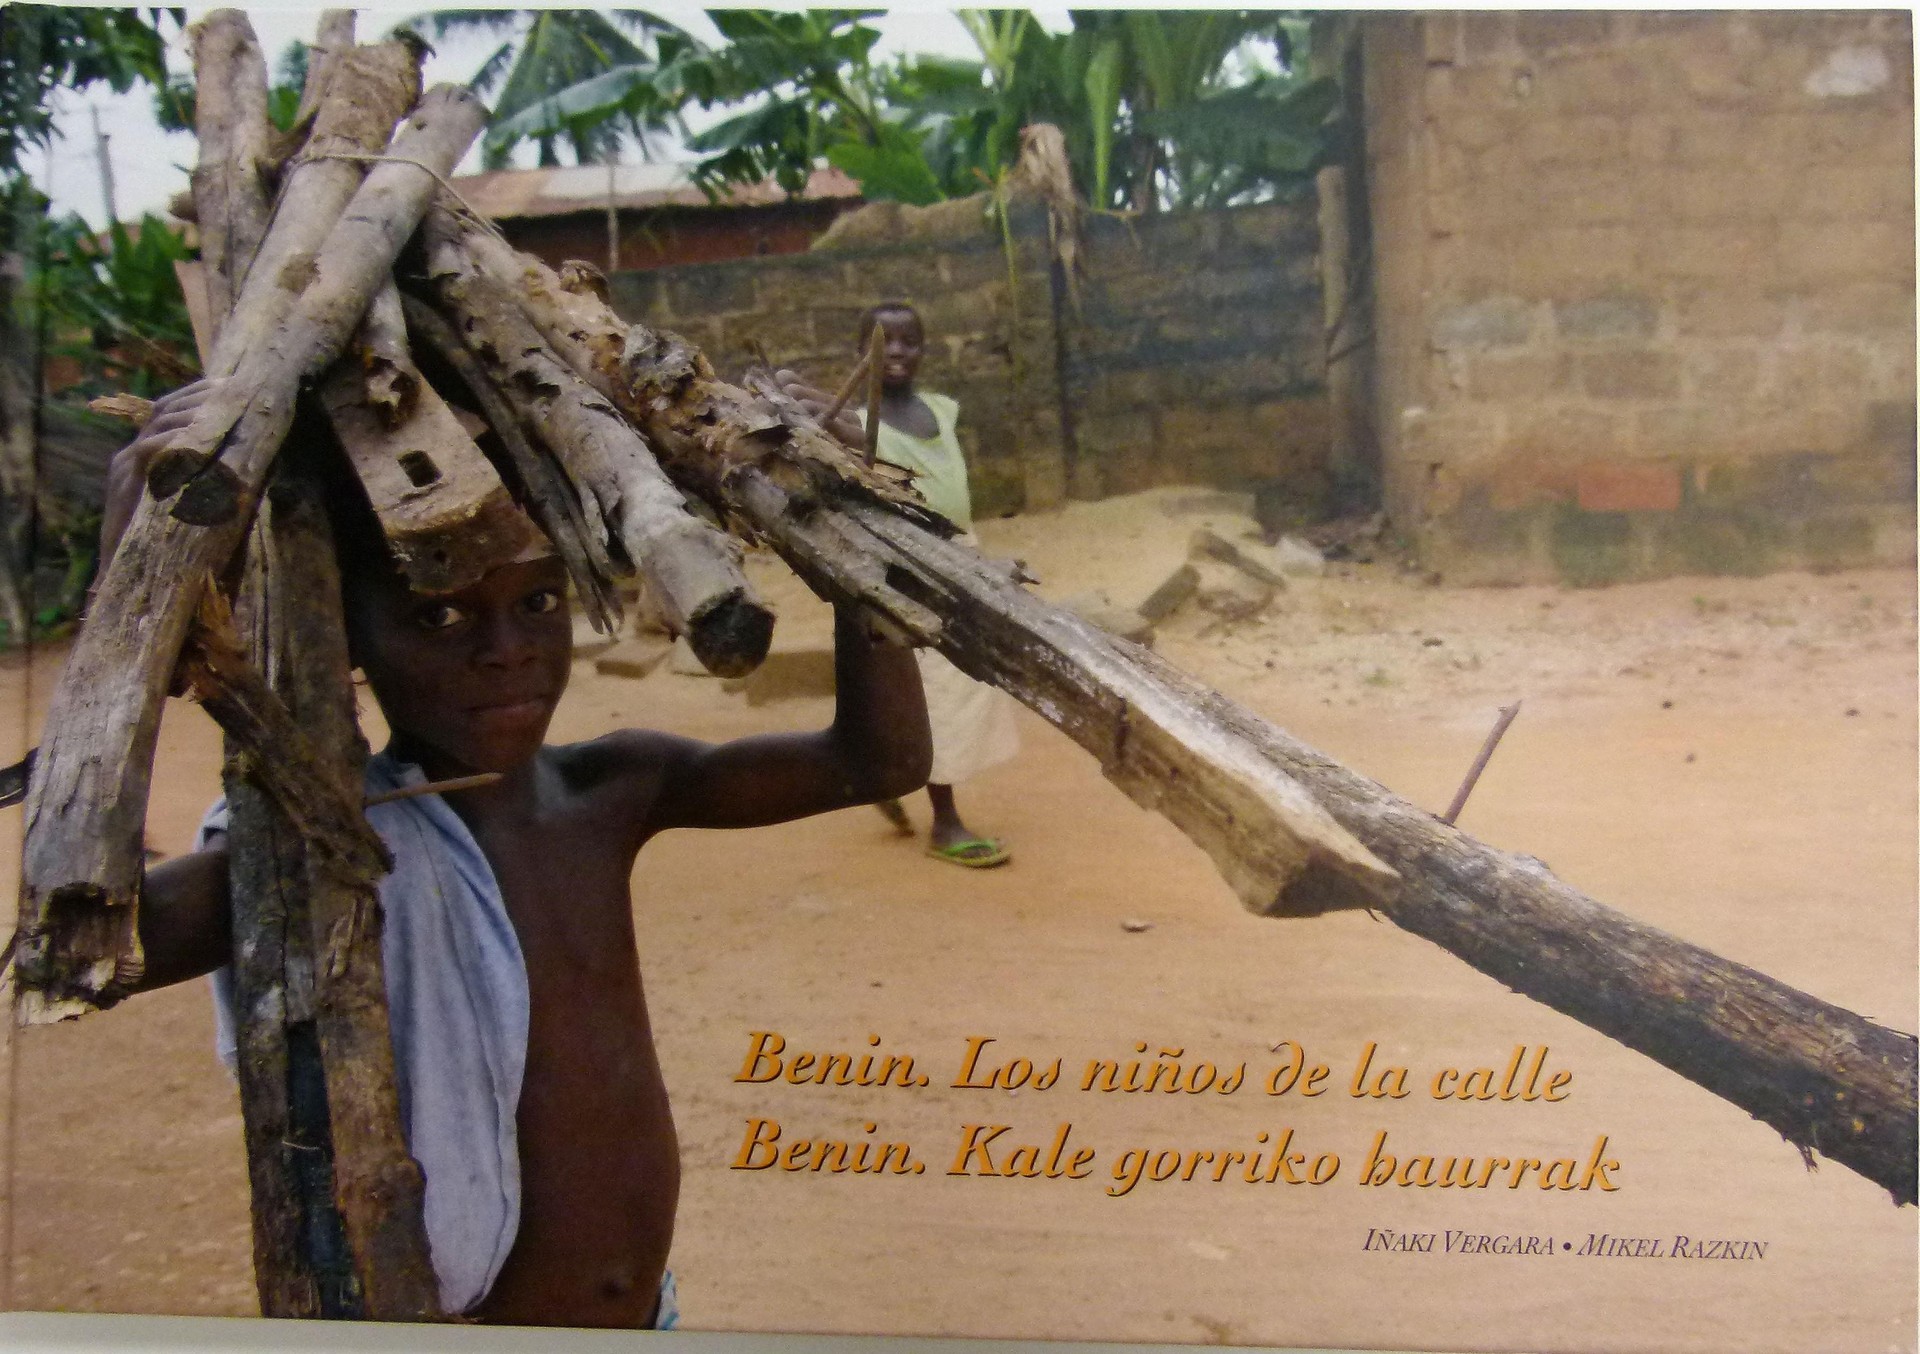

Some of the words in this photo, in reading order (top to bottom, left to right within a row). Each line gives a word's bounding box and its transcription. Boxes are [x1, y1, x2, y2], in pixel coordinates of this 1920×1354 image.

[734, 1030, 930, 1087] Benin.
[950, 1036, 1061, 1091] Los
[1081, 1041, 1247, 1095] niños
[1264, 1040, 1330, 1098] de
[1349, 1041, 1410, 1099] la
[1429, 1044, 1573, 1102] calle
[730, 1117, 926, 1175] Benin.
[946, 1123, 1095, 1179] Kale
[1105, 1128, 1341, 1198] gorriko
[1359, 1130, 1623, 1193] haurrak
[1362, 1228, 1436, 1255] IÑAKI
[1442, 1230, 1555, 1257] VERGARA
[1576, 1233, 1665, 1260] MIKEL
[1669, 1234, 1769, 1262] RAZKIN
